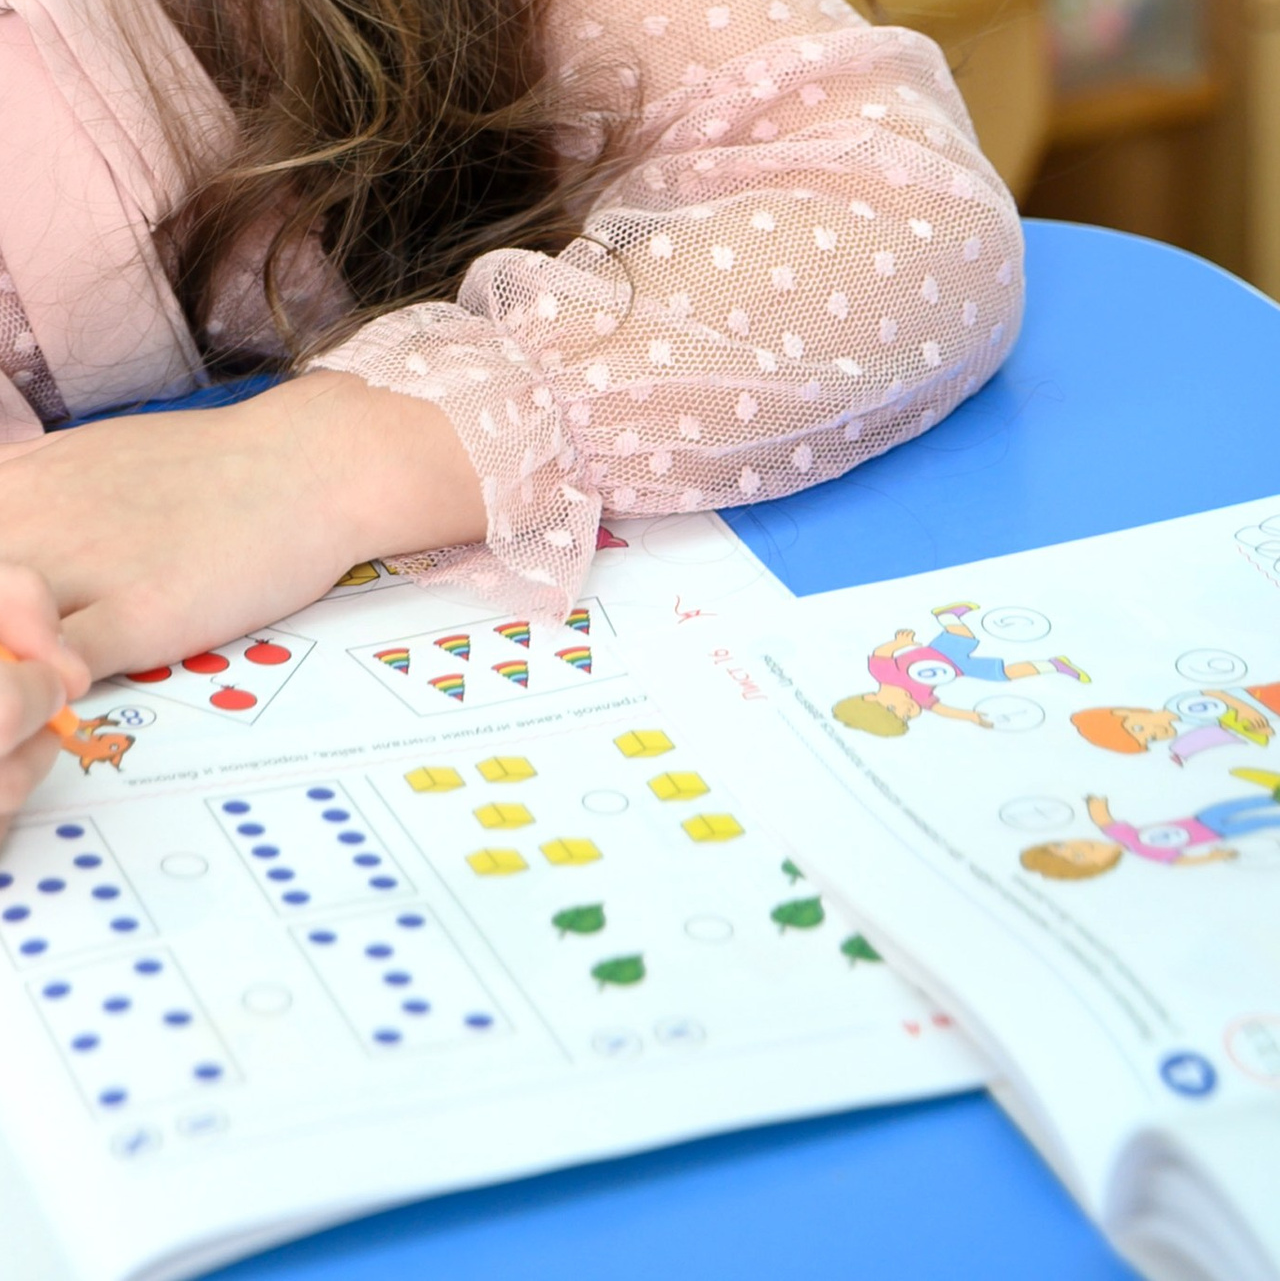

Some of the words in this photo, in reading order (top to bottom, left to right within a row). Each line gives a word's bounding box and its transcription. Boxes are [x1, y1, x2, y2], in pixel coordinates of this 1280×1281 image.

[916, 667, 947, 679] 9
[566, 694, 650, 718] стрелкой,
[120, 708, 144, 727] 8
[516, 714, 563, 729] какие
[442, 722, 511, 741] игрушки
[313, 744, 367, 760] зайка,
[372, 735, 437, 752] считали
[203, 766, 214, 776] и
[219, 754, 308, 773] поросёнок
[123, 769, 199, 787] белочка.
